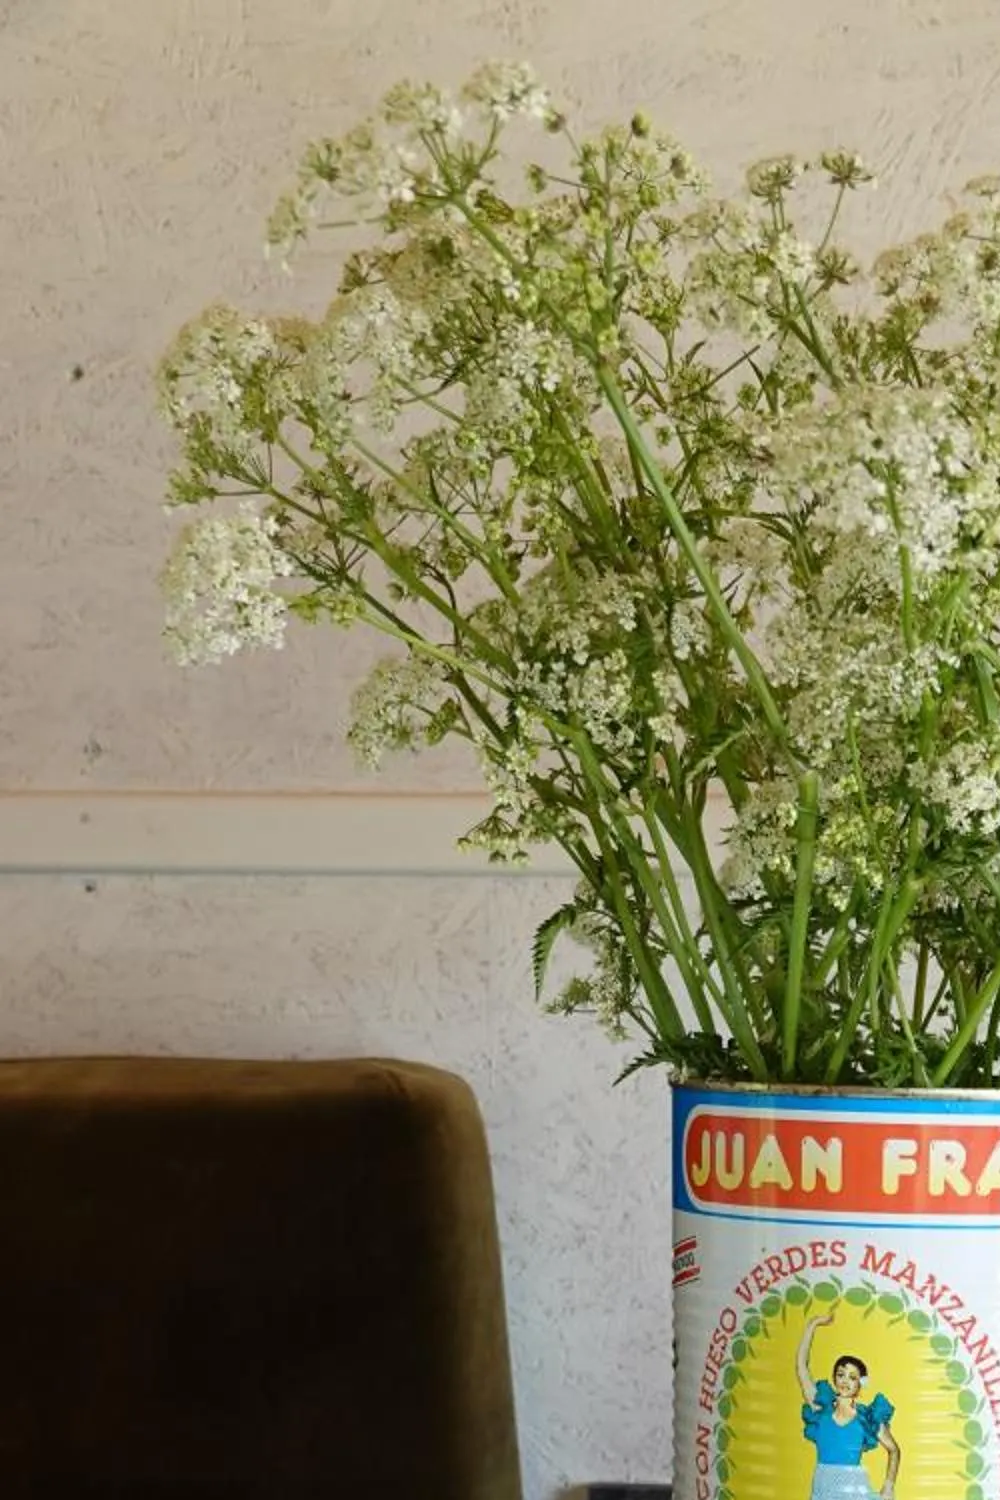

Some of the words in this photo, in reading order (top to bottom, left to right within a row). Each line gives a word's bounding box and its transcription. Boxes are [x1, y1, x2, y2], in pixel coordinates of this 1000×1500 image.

[691, 1131, 843, 1194] JUAN
[700, 1307, 737, 1414] HUESO
[735, 1240, 847, 1305] VERDES
